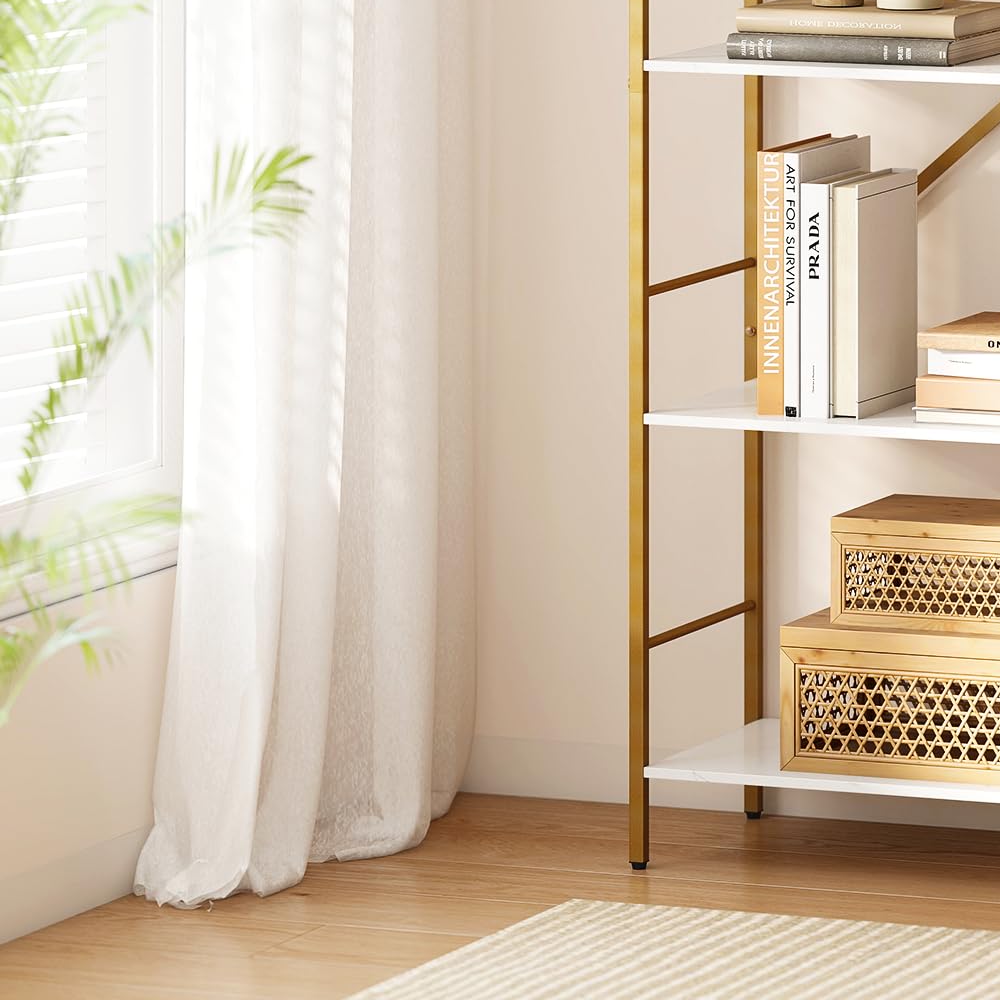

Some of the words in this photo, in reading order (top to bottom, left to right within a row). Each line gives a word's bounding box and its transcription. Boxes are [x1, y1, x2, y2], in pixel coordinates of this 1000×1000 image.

[786, 164, 796, 193] ART
[786, 199, 796, 230] FOR
[808, 211, 820, 280] PRADA
[763, 152, 780, 374] INNENARCHITEKTUR
[786, 235, 796, 306] SURVIVAL
